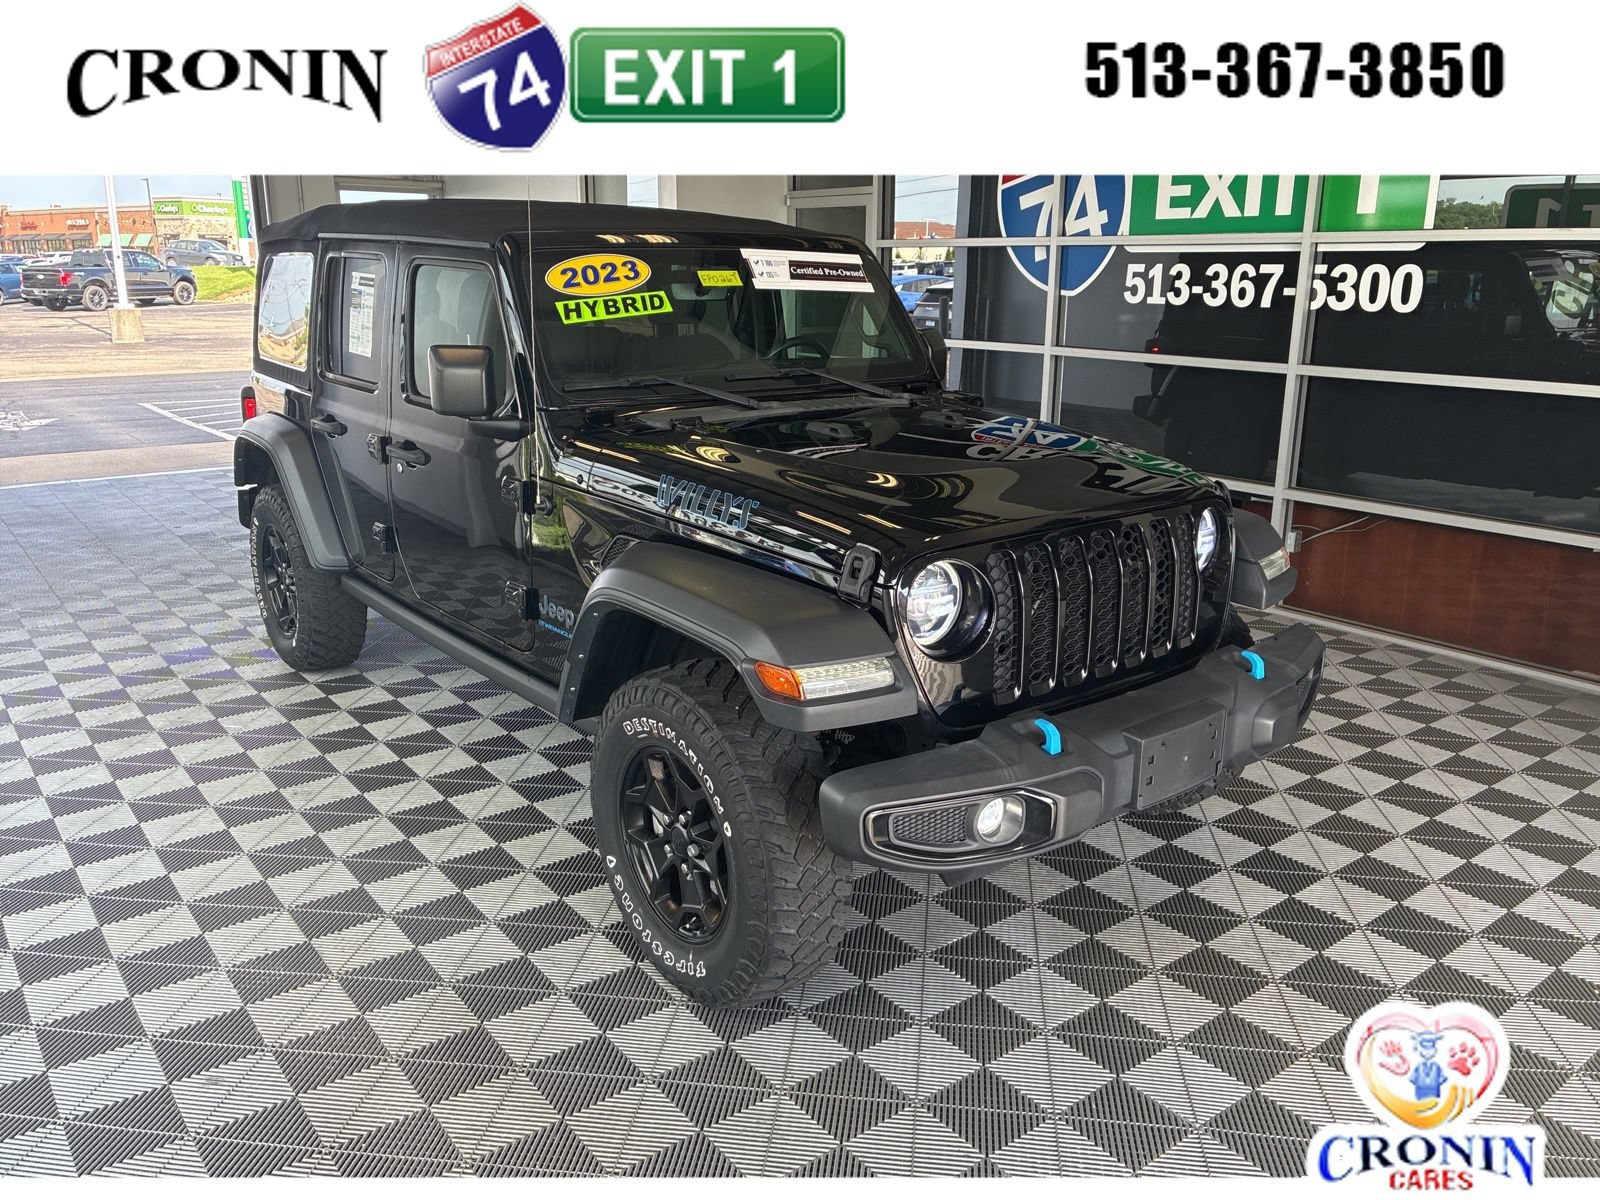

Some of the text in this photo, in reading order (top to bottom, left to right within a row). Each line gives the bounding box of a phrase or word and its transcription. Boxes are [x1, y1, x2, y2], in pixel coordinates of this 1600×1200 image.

[1155, 174, 1298, 221] EXIT
[1019, 174, 1109, 262] 74
[560, 260, 640, 289] 2023
[790, 266, 824, 275] Certified
[824, 268, 865, 277] Pre-Owned
[1123, 263, 1424, 313] 513-367-5300
[563, 293, 666, 321] HYBRID
[539, 595, 575, 629] Jeep
[622, 716, 725, 815] DESTINATION
